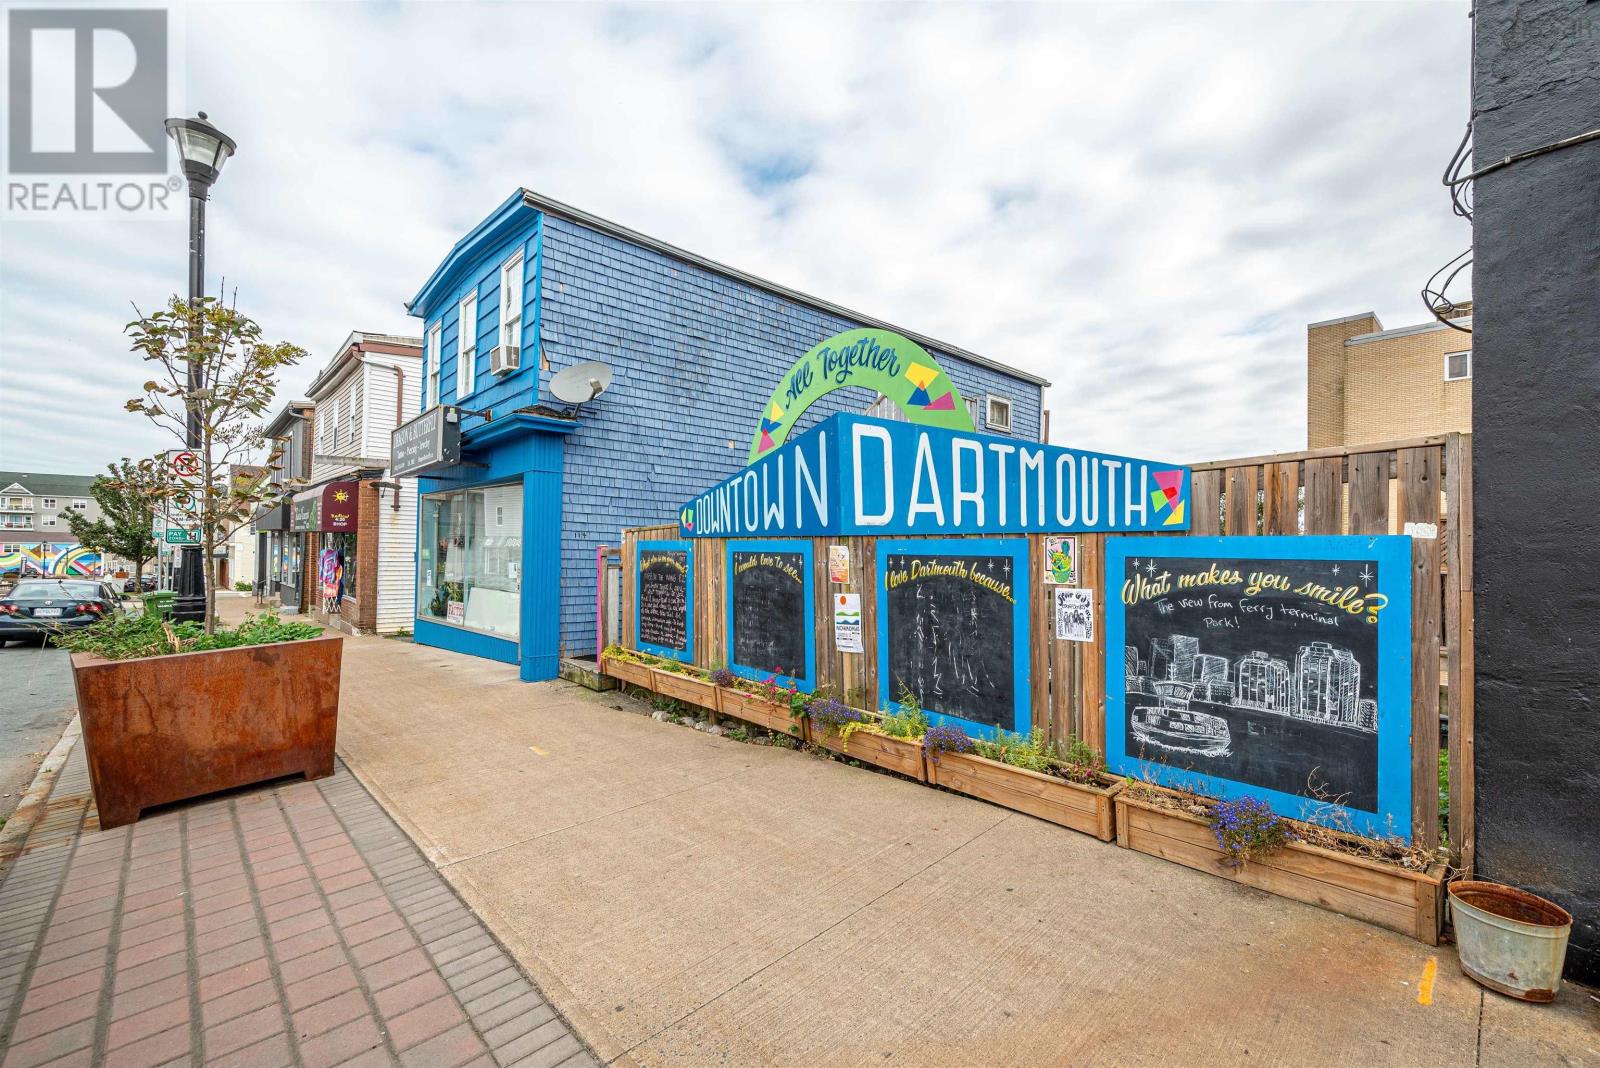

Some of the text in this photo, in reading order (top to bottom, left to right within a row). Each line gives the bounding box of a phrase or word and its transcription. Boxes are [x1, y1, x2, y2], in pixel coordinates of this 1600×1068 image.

[785, 336, 901, 410] All Together
[696, 423, 1148, 535] DOWNTOWN DARTMOUTH
[738, 554, 758, 572] would
[760, 553, 774, 567] love
[884, 571, 889, 592] I
[890, 569, 908, 588] love
[911, 559, 968, 581] Dartmouth
[1121, 570, 1171, 605] What
[1178, 562, 1243, 589] makes
[1243, 569, 1291, 596] you
[1293, 580, 1389, 624] smile?
[1154, 597, 1175, 615] The
[1280, 603, 1340, 627] terminal
